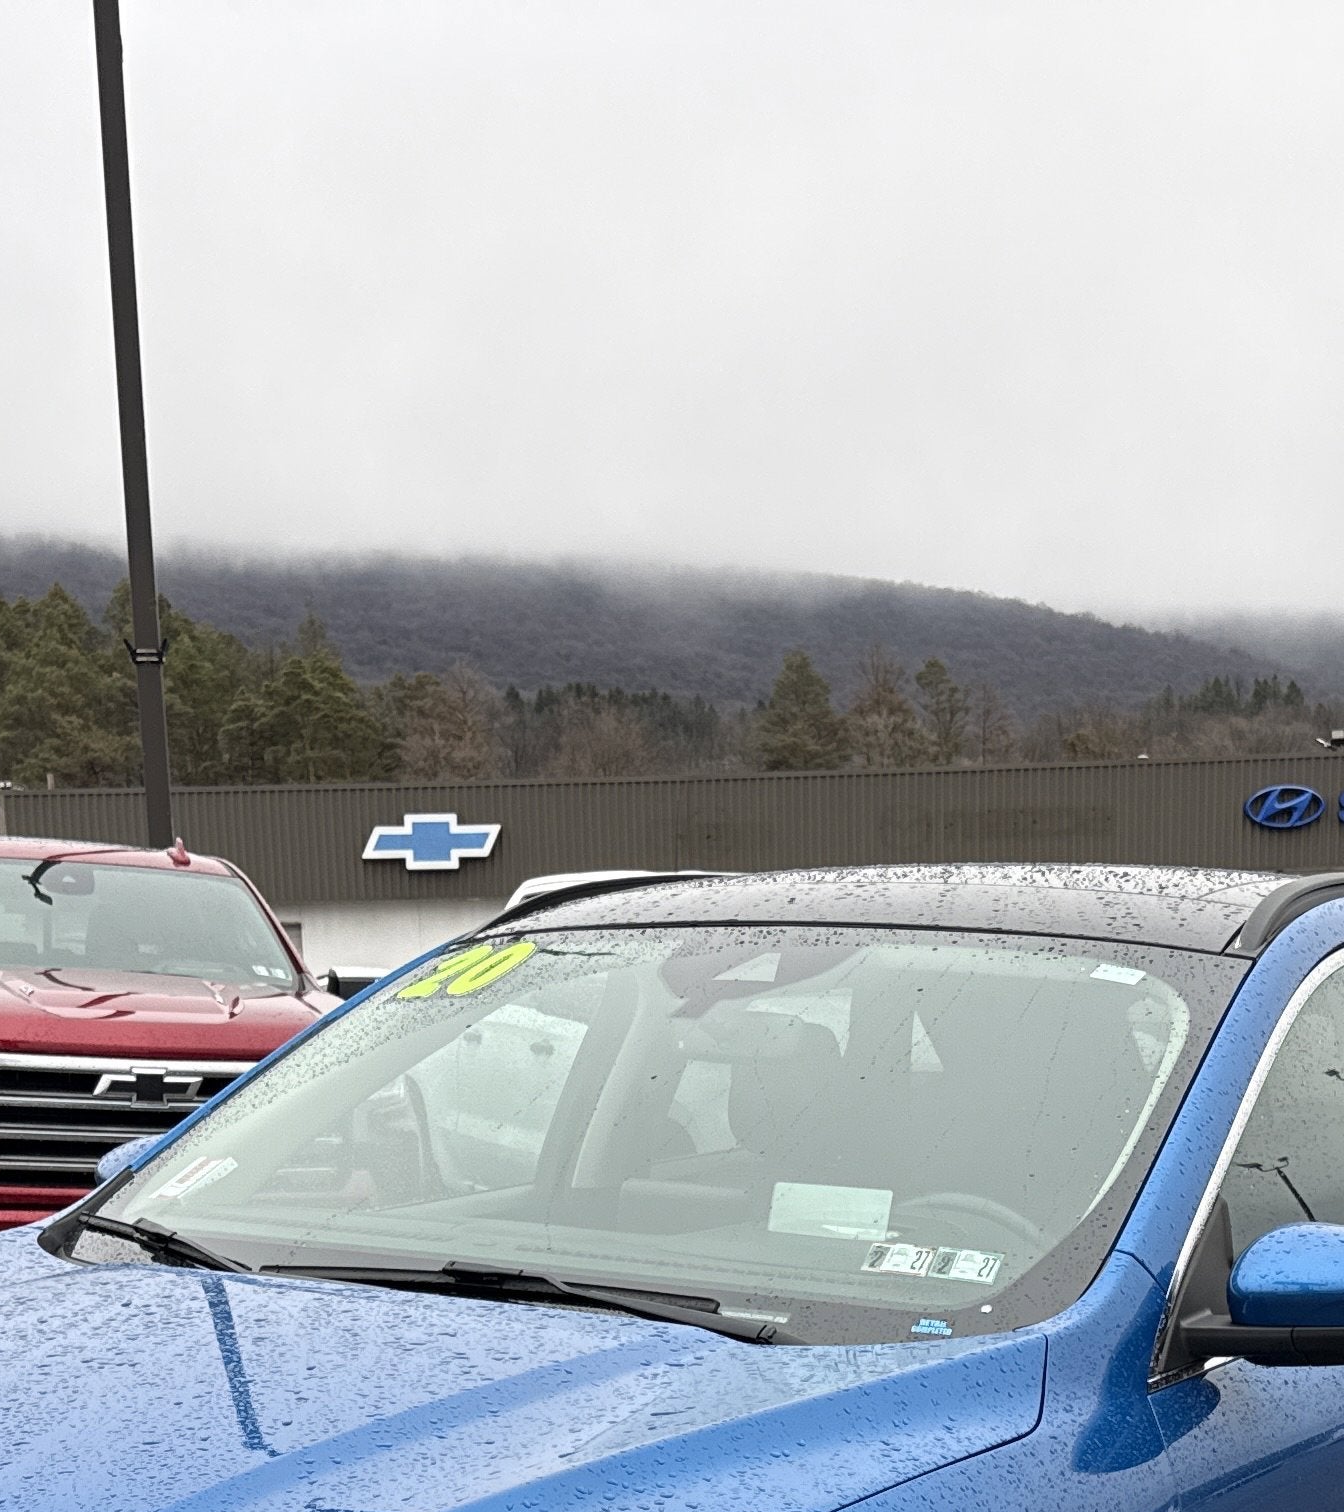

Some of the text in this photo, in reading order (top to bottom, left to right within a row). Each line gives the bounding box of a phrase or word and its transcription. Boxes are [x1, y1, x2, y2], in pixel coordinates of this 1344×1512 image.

[396, 941, 538, 999] 20
[910, 1250, 931, 1272] 27
[977, 1257, 998, 1279] 27
